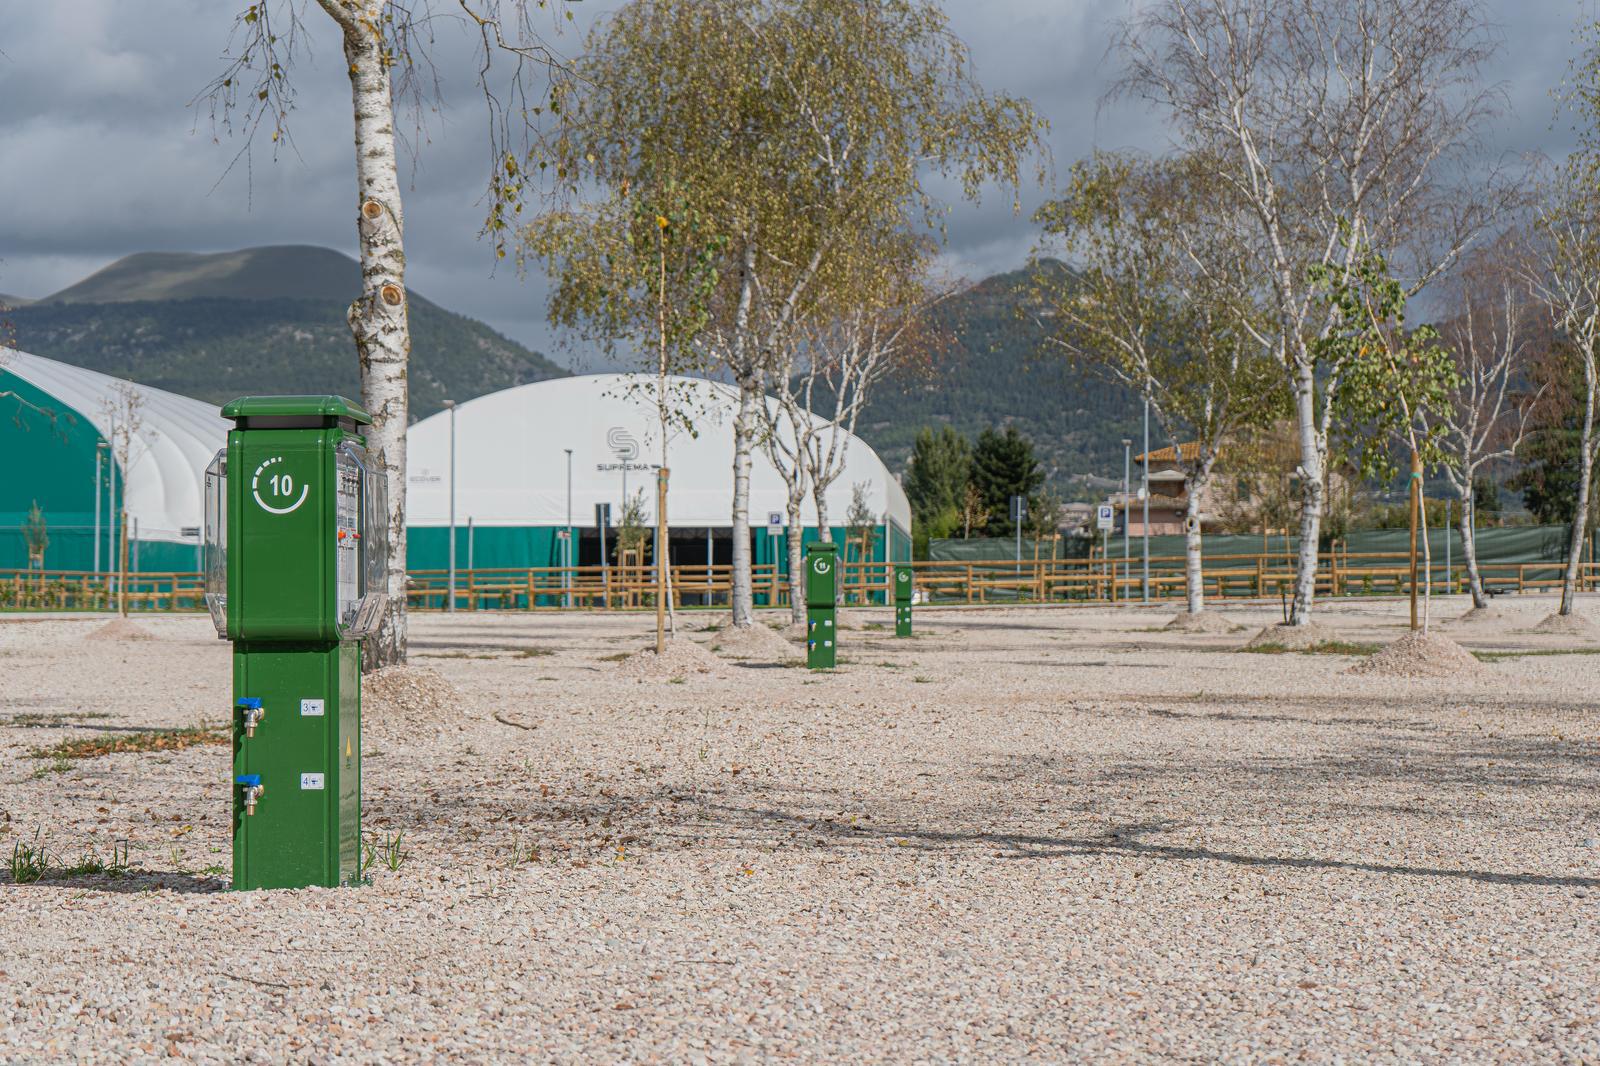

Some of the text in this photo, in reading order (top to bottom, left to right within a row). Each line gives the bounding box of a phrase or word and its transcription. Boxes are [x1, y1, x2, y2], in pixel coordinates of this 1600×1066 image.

[597, 463, 649, 471] SUPREMA
[269, 474, 293, 496] 10
[303, 702, 309, 712] 3
[303, 776, 309, 786] 4
